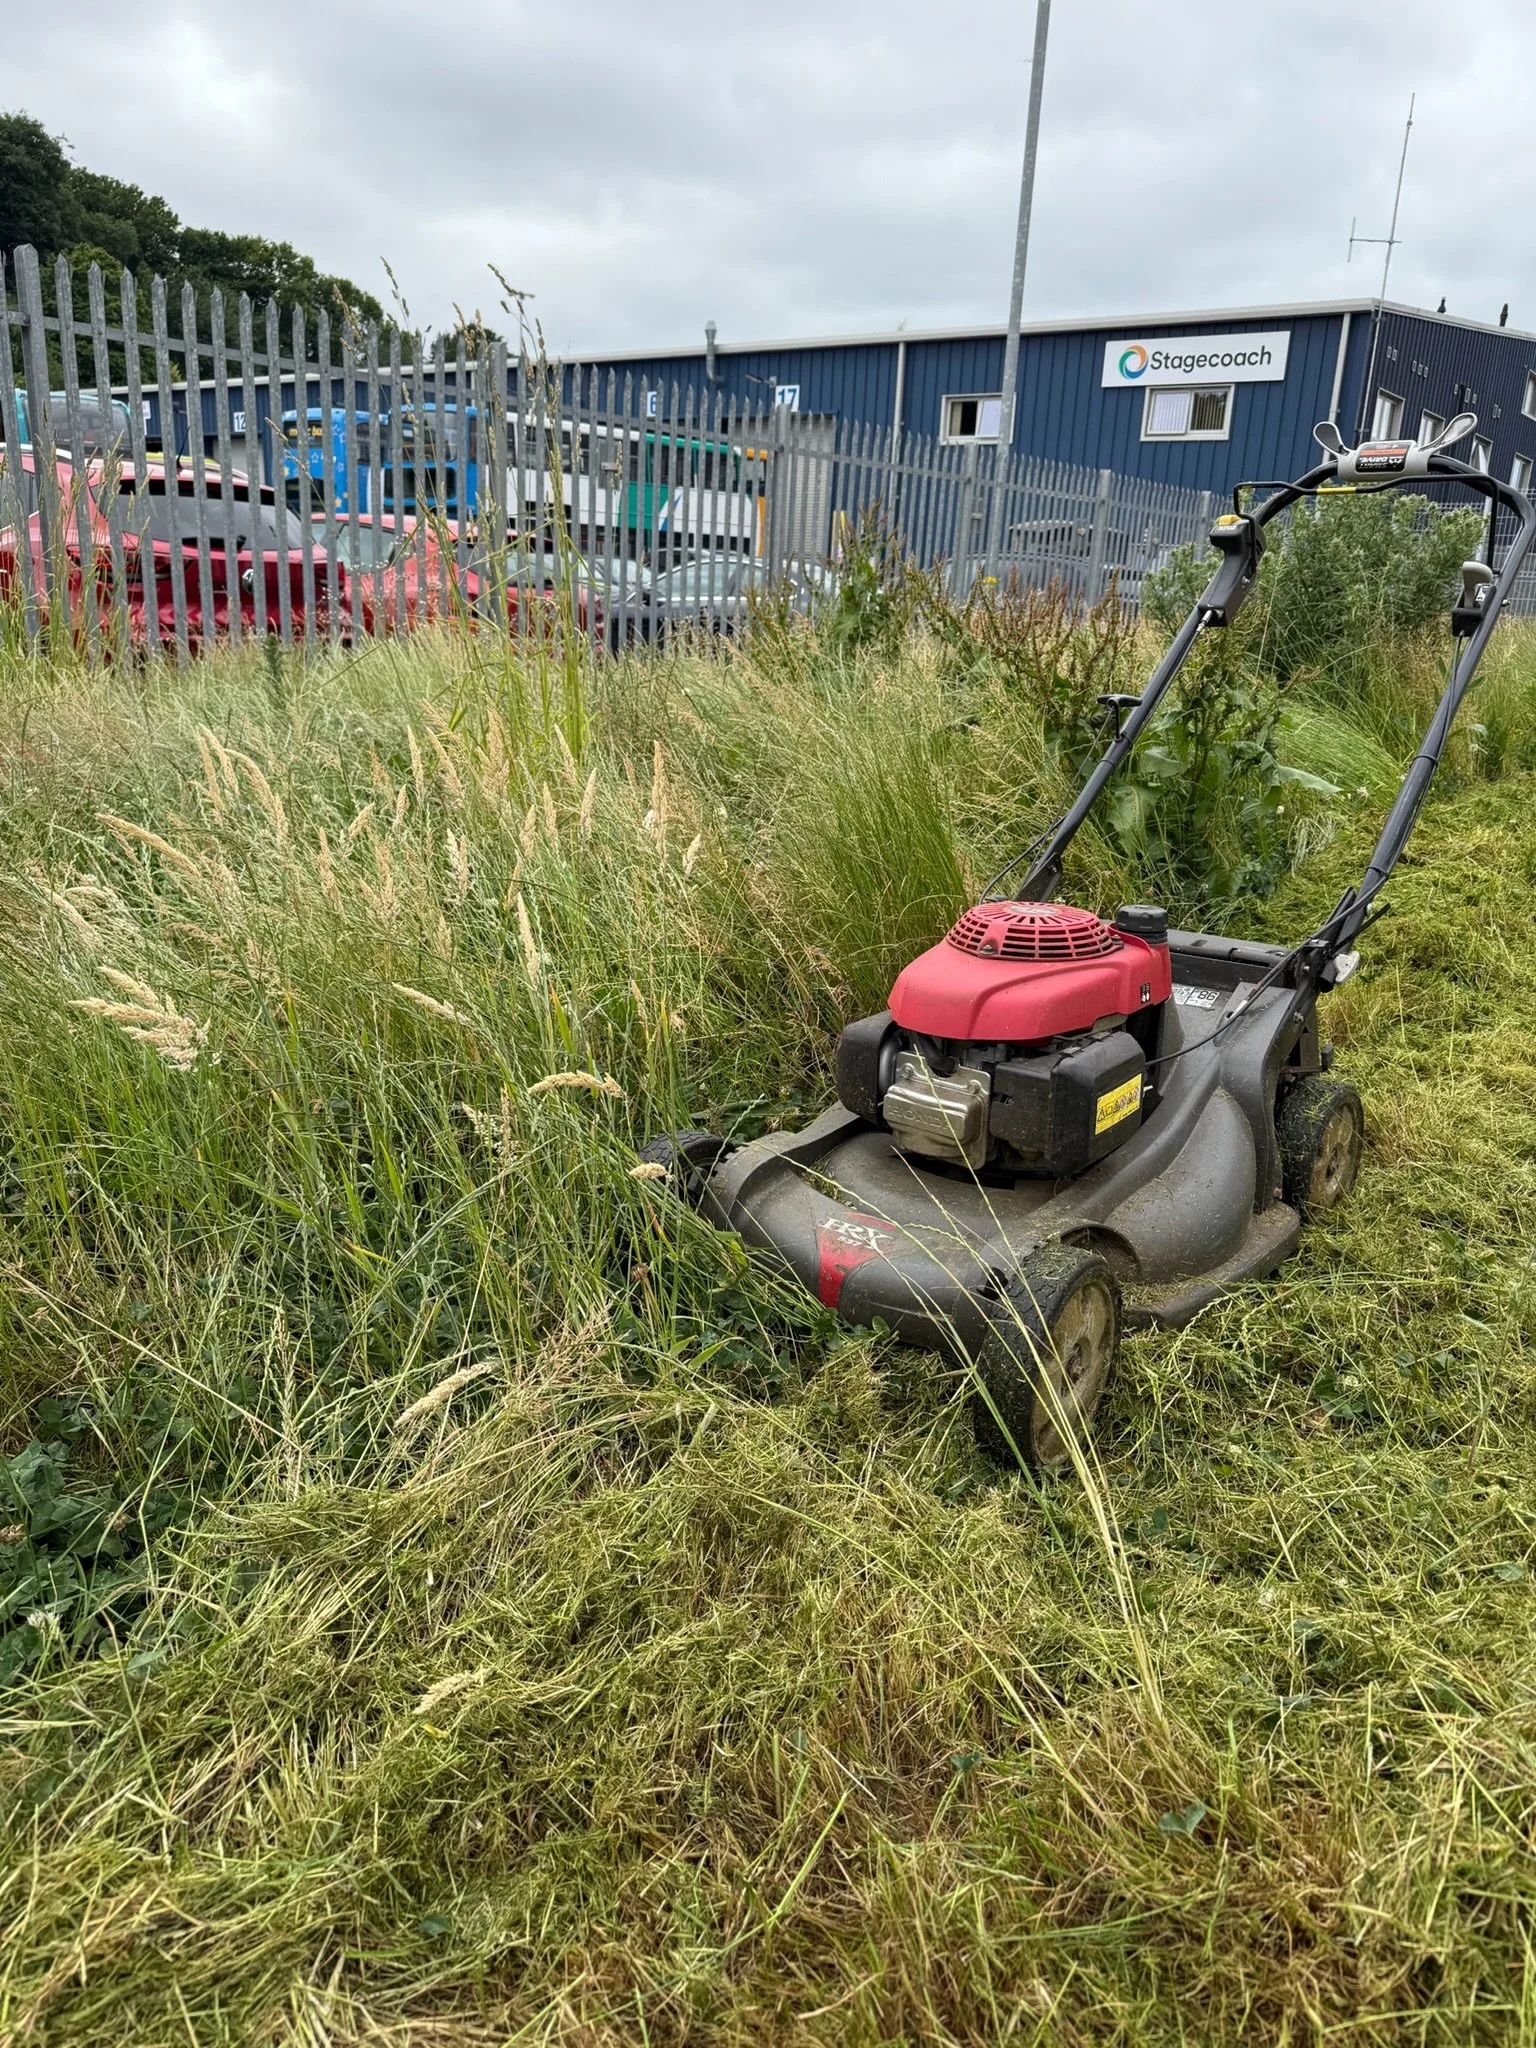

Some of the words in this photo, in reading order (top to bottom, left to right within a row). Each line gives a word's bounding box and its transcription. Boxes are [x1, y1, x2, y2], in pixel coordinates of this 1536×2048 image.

[1150, 345, 1272, 374] Stagecoach
[778, 388, 797, 409] 17
[819, 1216, 894, 1253] HRX
